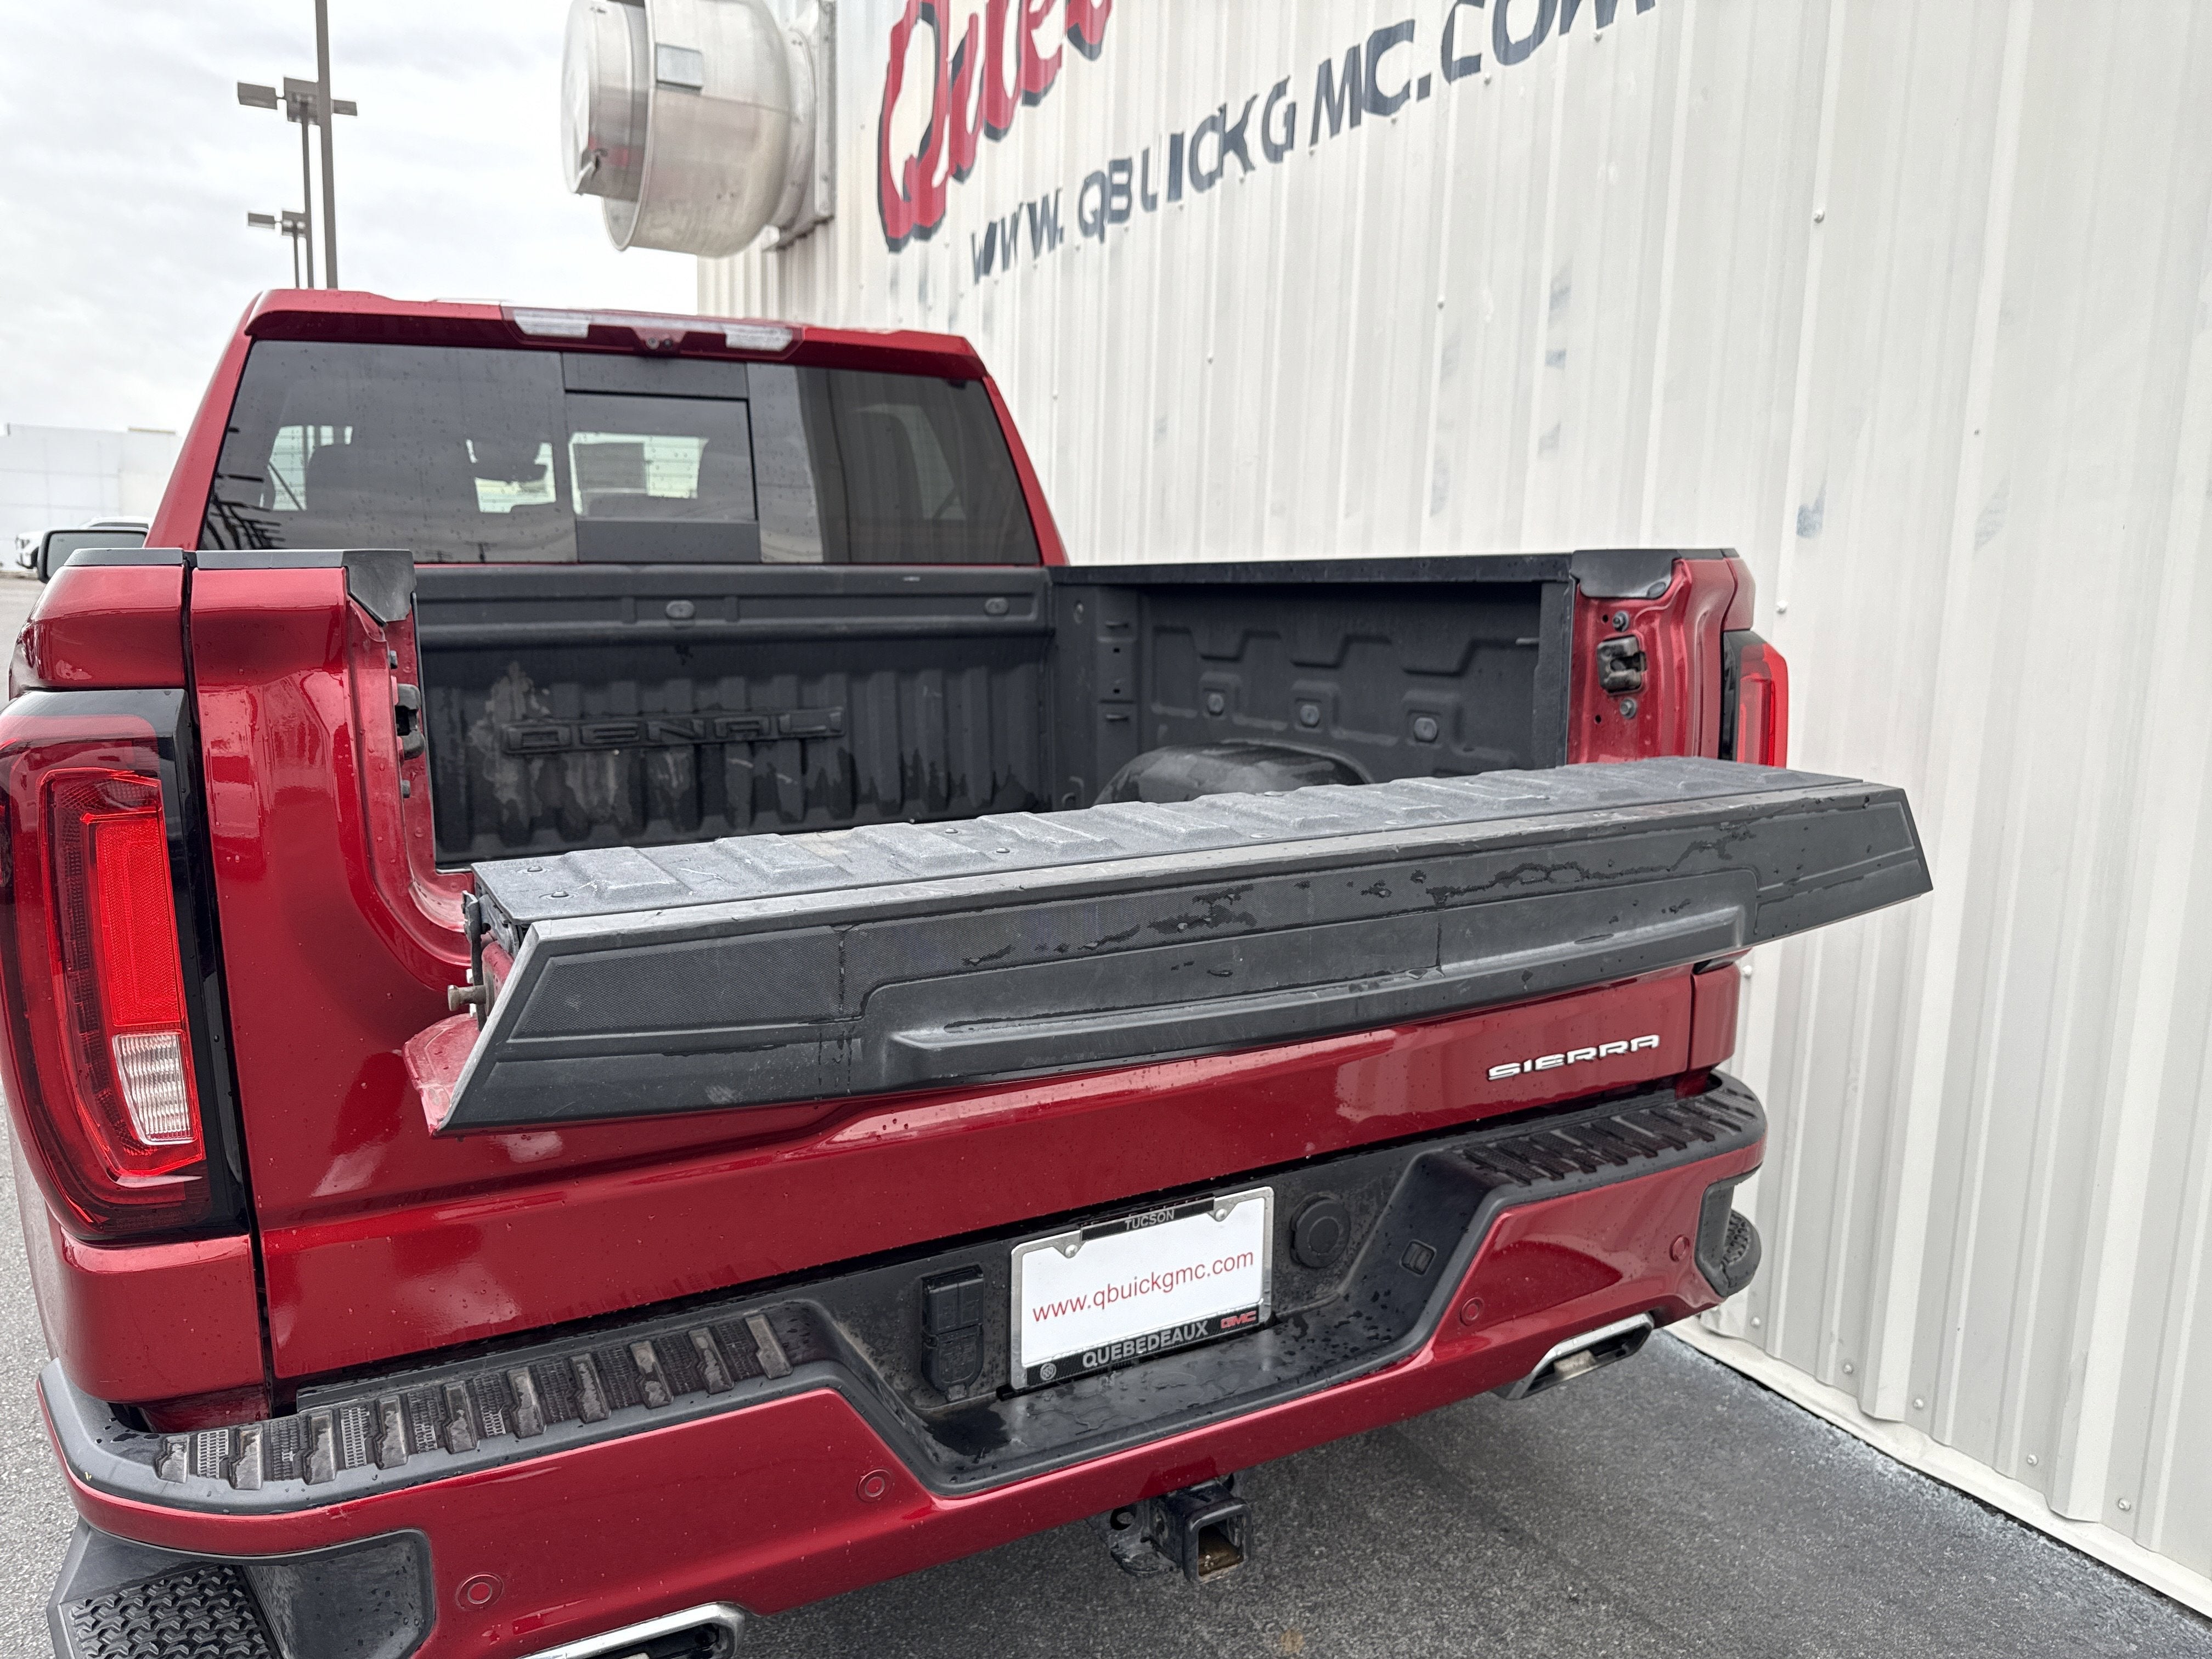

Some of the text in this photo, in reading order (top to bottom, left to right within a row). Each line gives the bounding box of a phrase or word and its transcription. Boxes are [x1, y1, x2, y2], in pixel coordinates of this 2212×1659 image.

[504, 708, 844, 752] DENALI
[1488, 1034, 1660, 1081] SIERRA
[1125, 1209, 1175, 1231] TUCSON
[1032, 1251, 1254, 1322] www.qbuickgmc.com
[1220, 1311, 1257, 1329] GMC
[1082, 1321, 1209, 1368] QUEBEDEAUX
